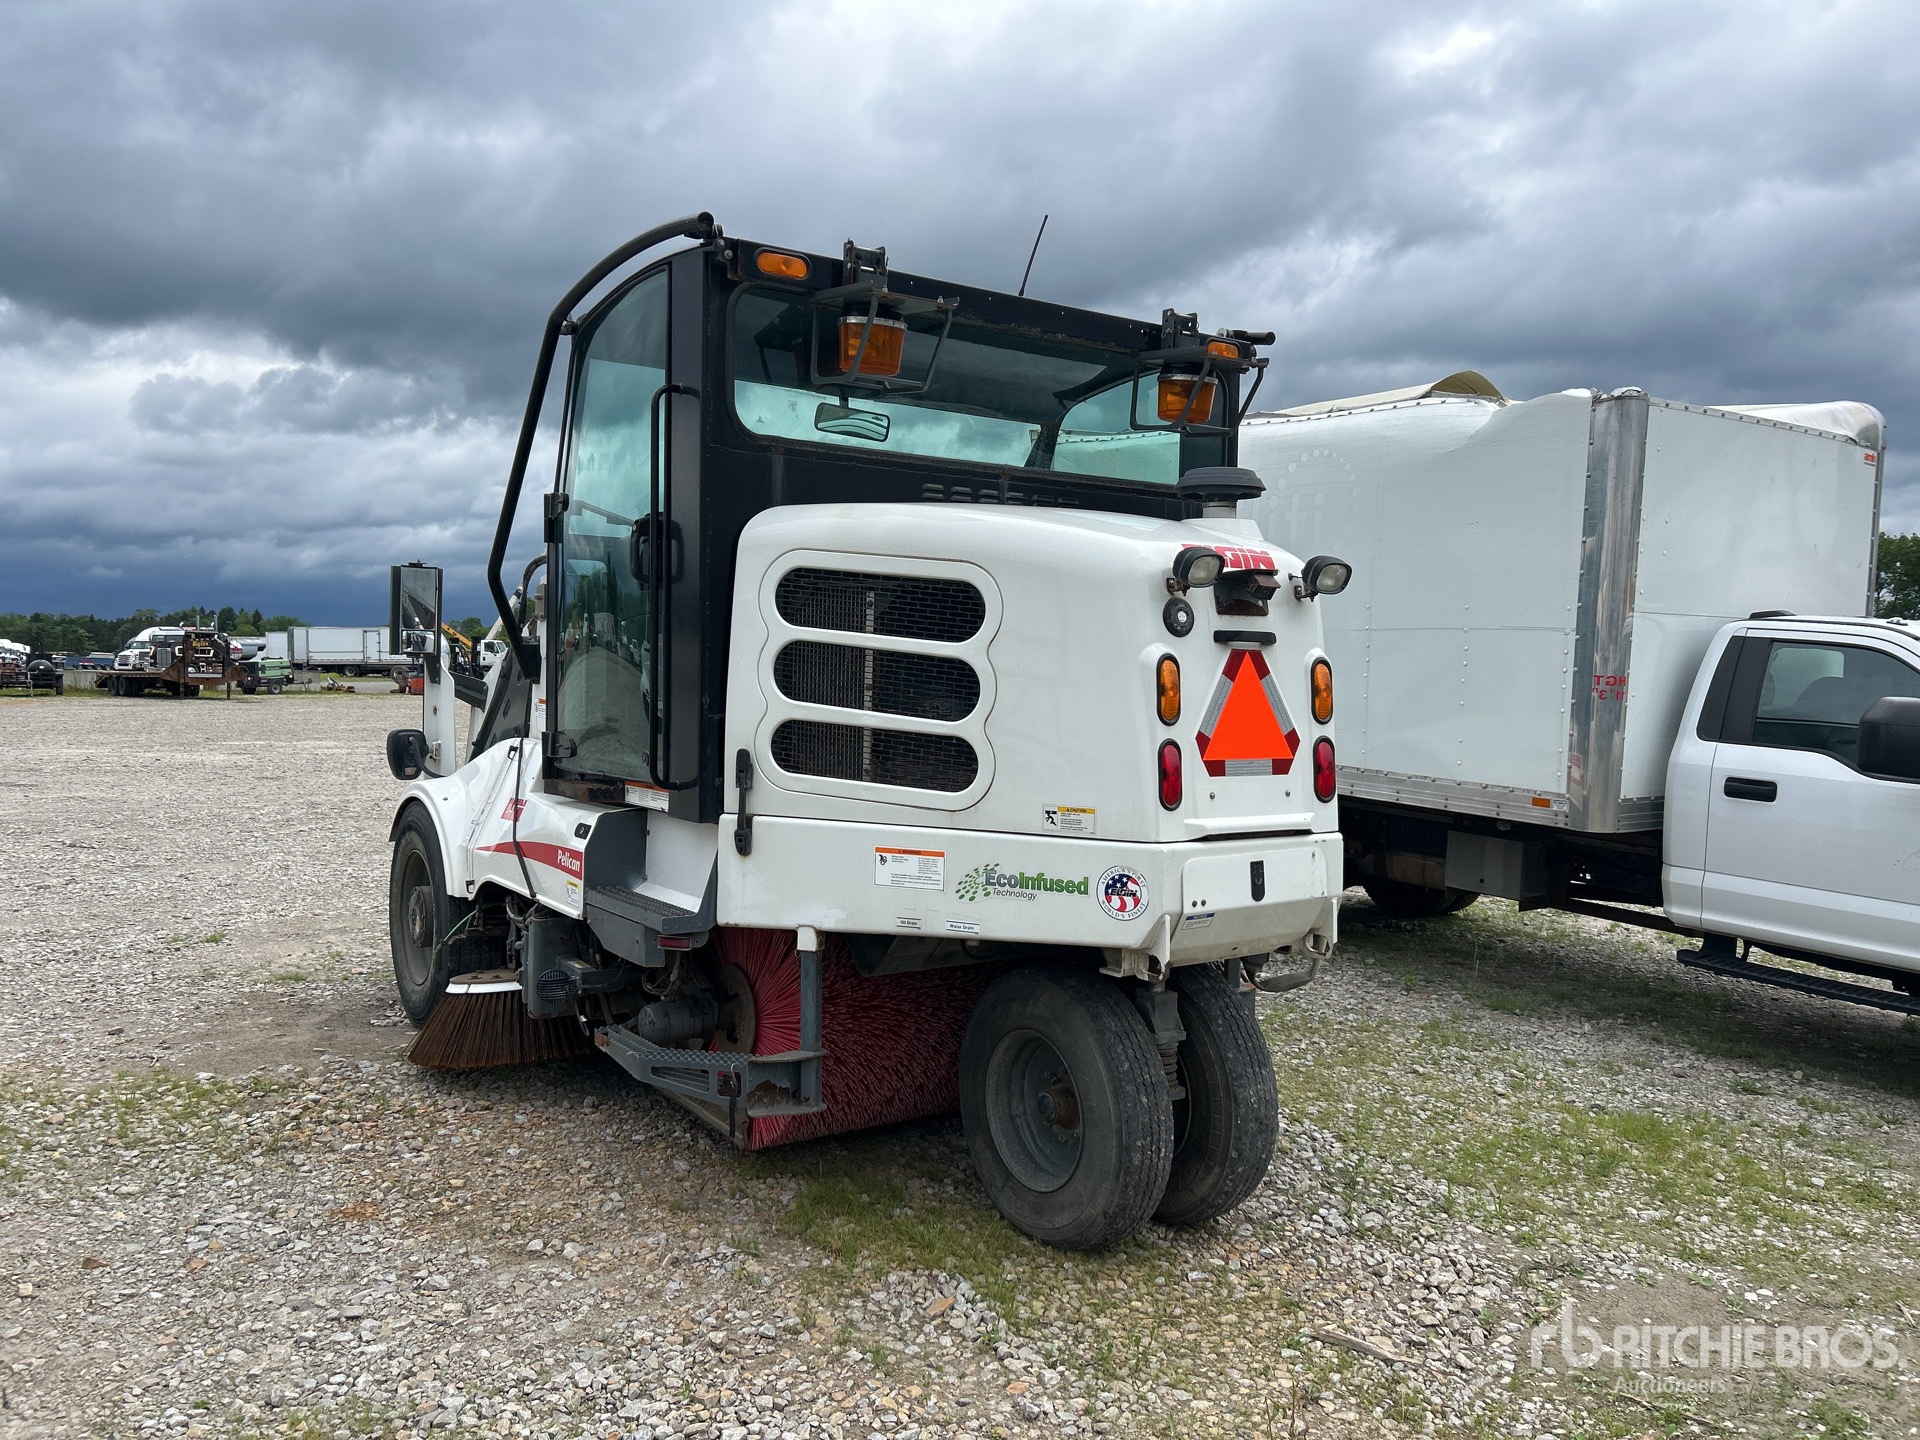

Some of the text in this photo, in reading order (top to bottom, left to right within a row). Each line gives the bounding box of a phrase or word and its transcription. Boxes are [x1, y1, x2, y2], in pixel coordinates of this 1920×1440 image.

[557, 849, 581, 872] Pelican
[984, 867, 1089, 895] EcoInfused
[992, 887, 1038, 901] Technology
[1110, 887, 1138, 897] ELGIN
[1127, 902, 1146, 918] FINEST
